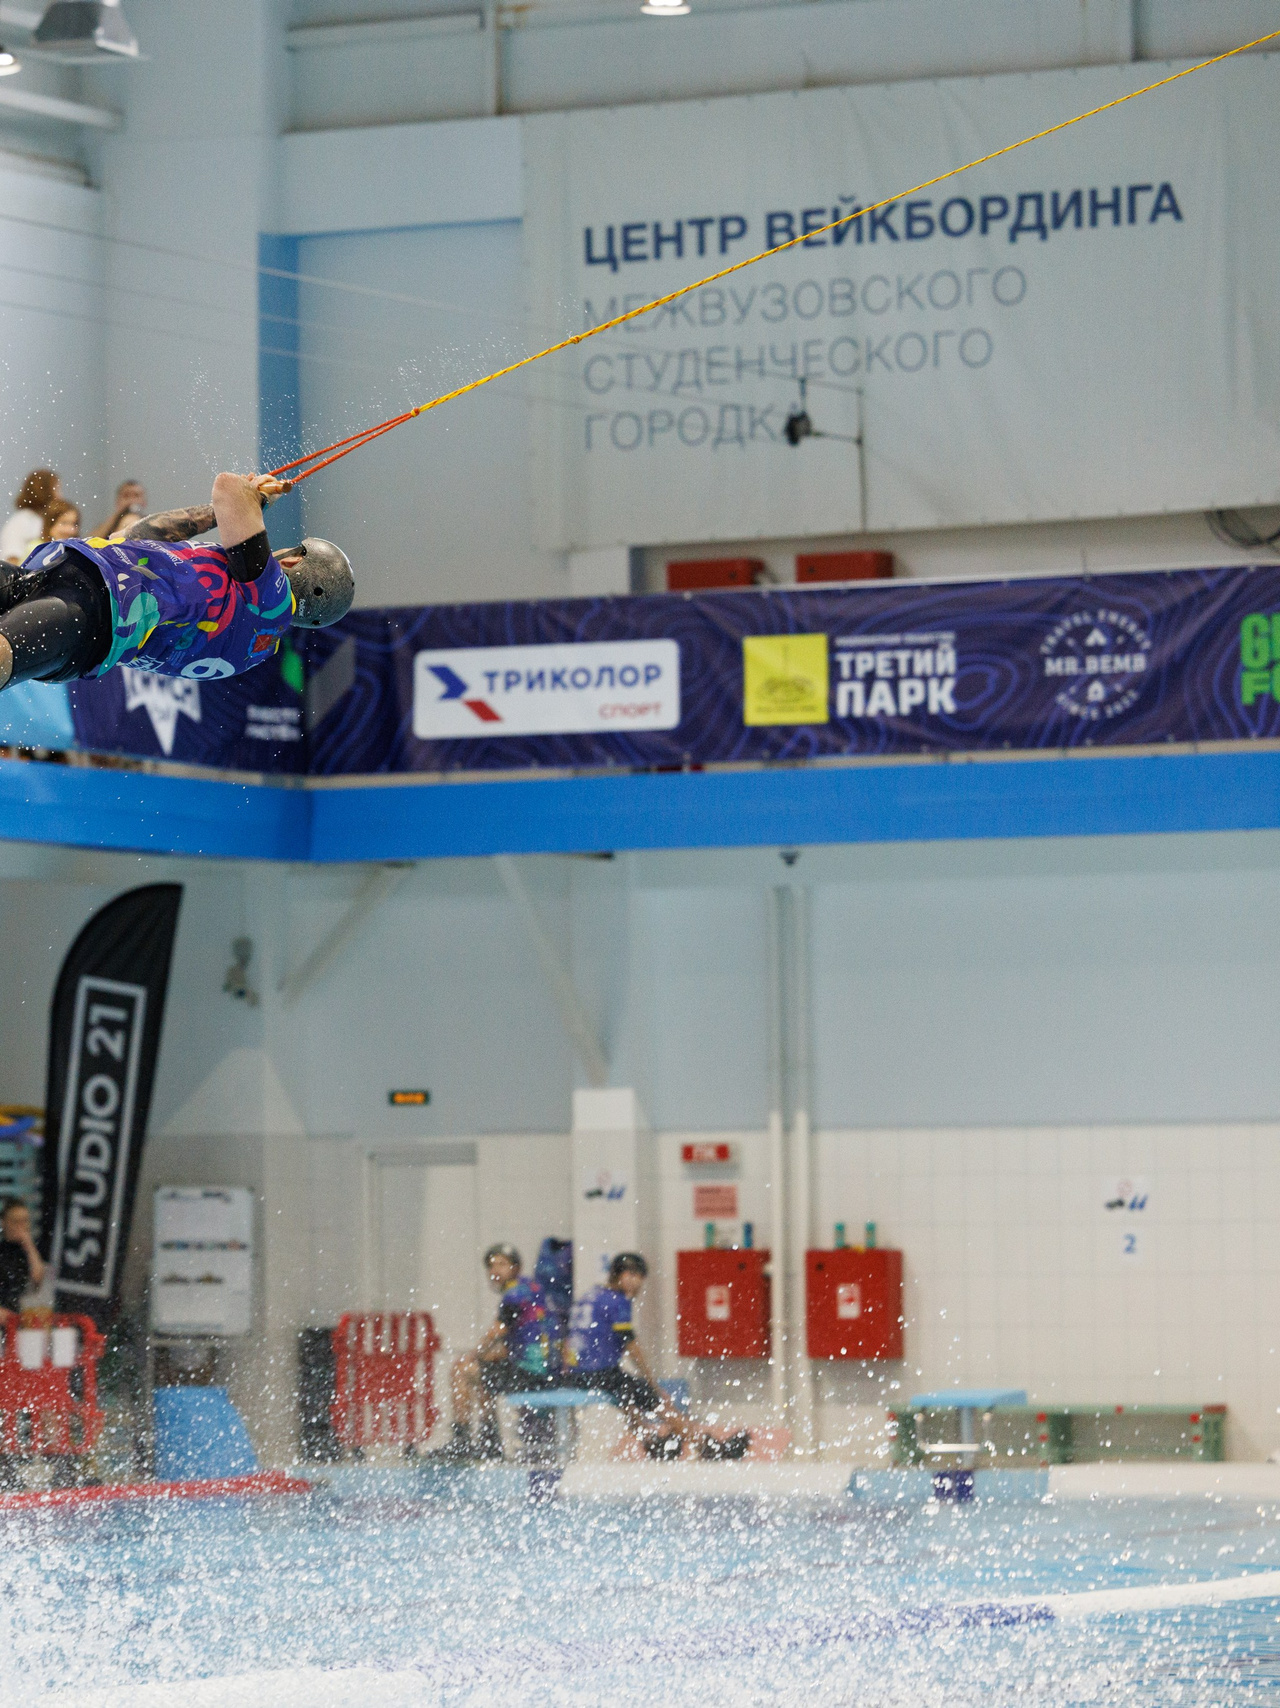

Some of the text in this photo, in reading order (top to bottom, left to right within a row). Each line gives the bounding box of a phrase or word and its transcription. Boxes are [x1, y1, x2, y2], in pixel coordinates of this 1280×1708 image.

[584, 183, 1183, 273] ЦЕНТР ВЕЙКБОРДИНГА
[583, 265, 1027, 335] МЕЖВУЗОВСКОГО
[584, 328, 994, 396] СТУДЕНЧЕСКОГО
[585, 402, 808, 451] ГОРОДК
[483, 663, 662, 693] ТРИКОЛОР
[835, 642, 957, 680] ТРЕТИЙ
[836, 676, 957, 718] ПАРК
[65, 1002, 129, 1269] STUDIO 21
[1123, 1232, 1137, 1254] 2
